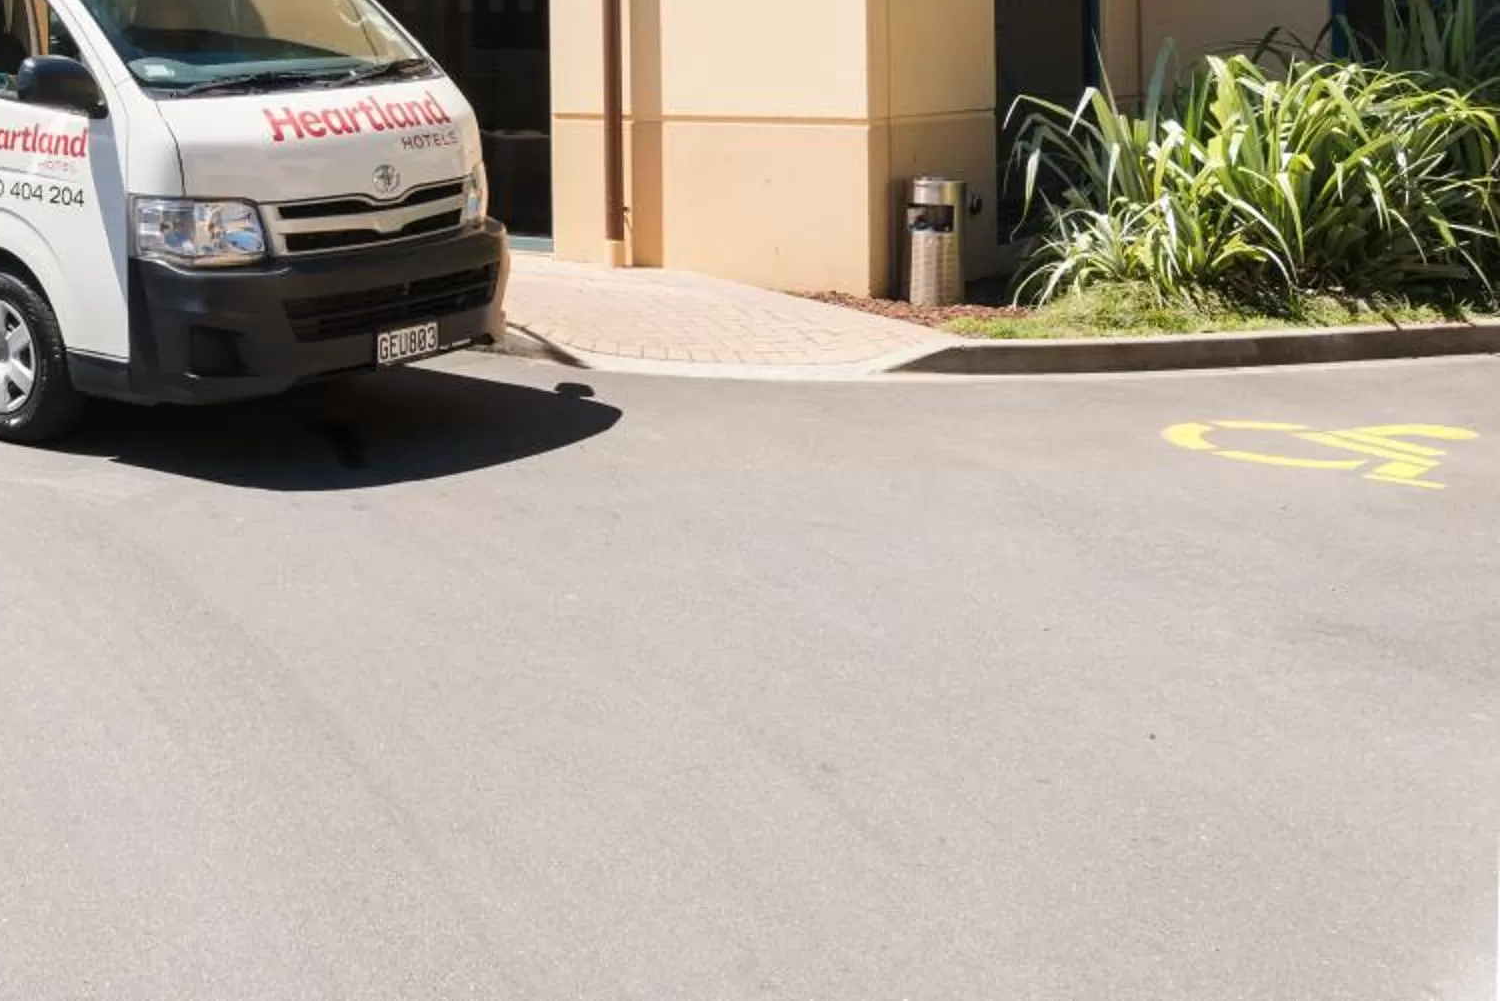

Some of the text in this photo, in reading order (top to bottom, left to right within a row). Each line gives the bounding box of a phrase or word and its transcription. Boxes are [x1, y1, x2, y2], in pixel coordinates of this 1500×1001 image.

[263, 91, 451, 141] Heartland
[401, 130, 458, 149] HOTELS
[9, 182, 43, 201] 404
[49, 186, 85, 208] 204
